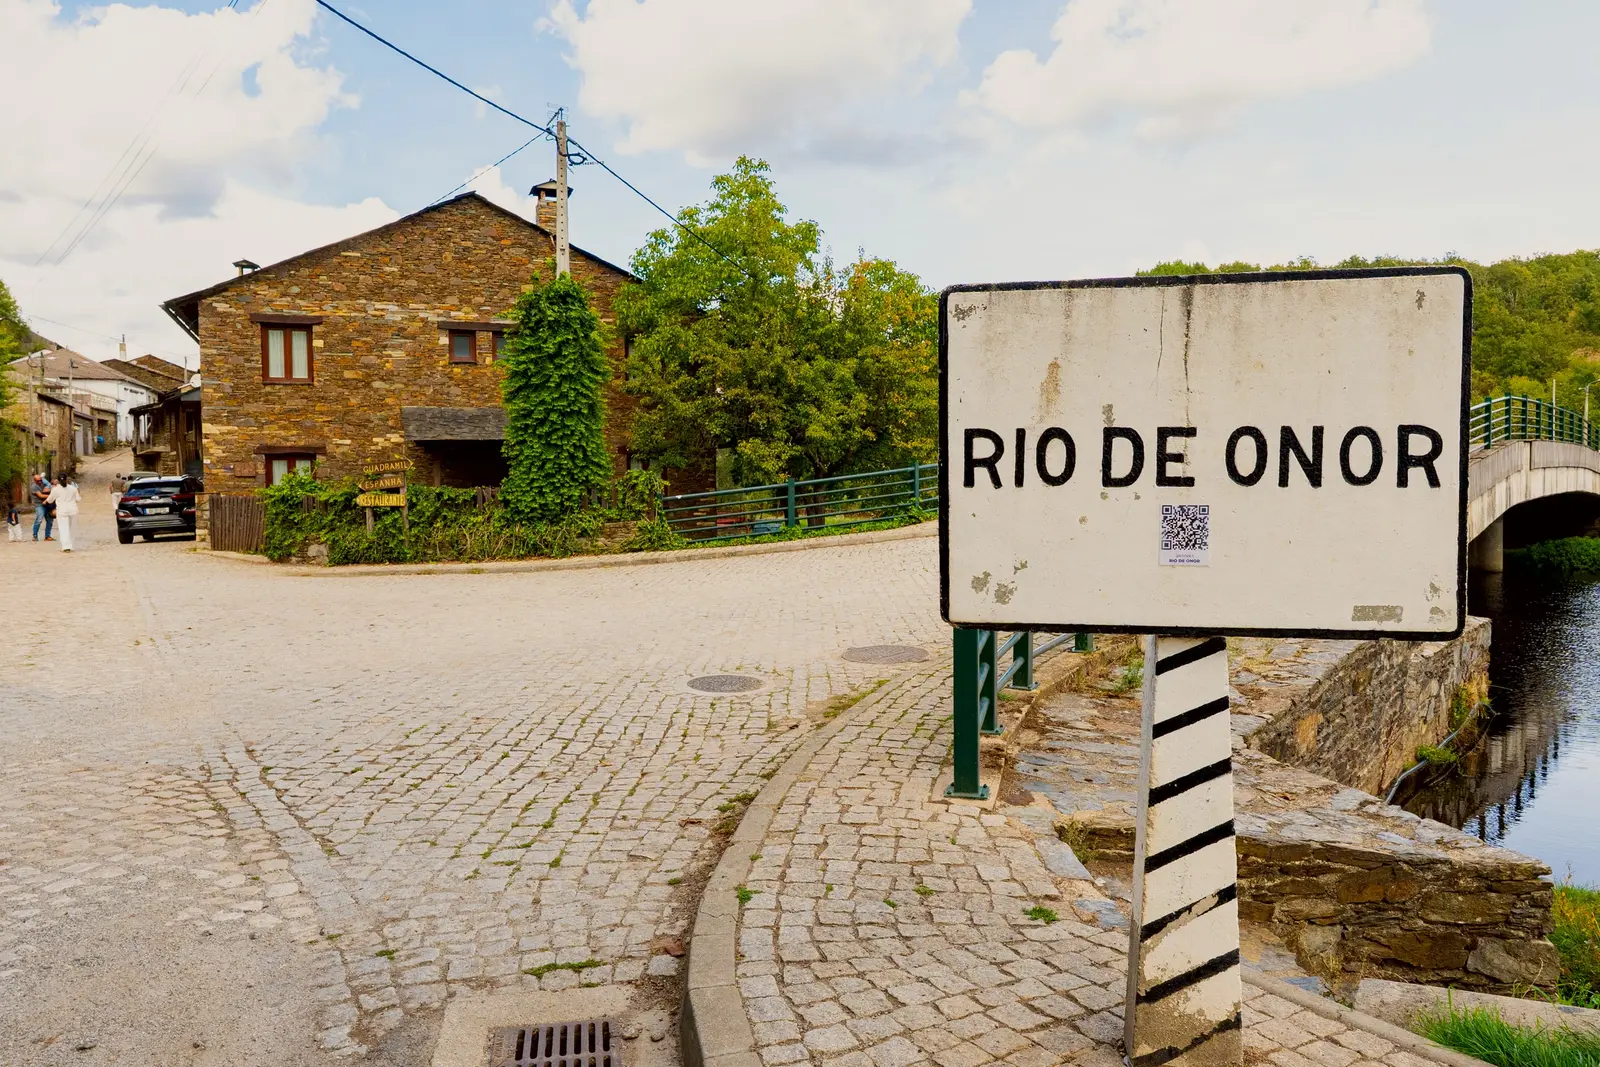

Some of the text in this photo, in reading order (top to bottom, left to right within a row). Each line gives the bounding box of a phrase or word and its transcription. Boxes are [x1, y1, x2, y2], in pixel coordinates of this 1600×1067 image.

[963, 424, 1443, 489] RIO DE ONOR
[363, 461, 408, 473] GUADRAMIL
[365, 478, 402, 488] ESPANHA
[359, 494, 405, 506] RESTAURANTE
